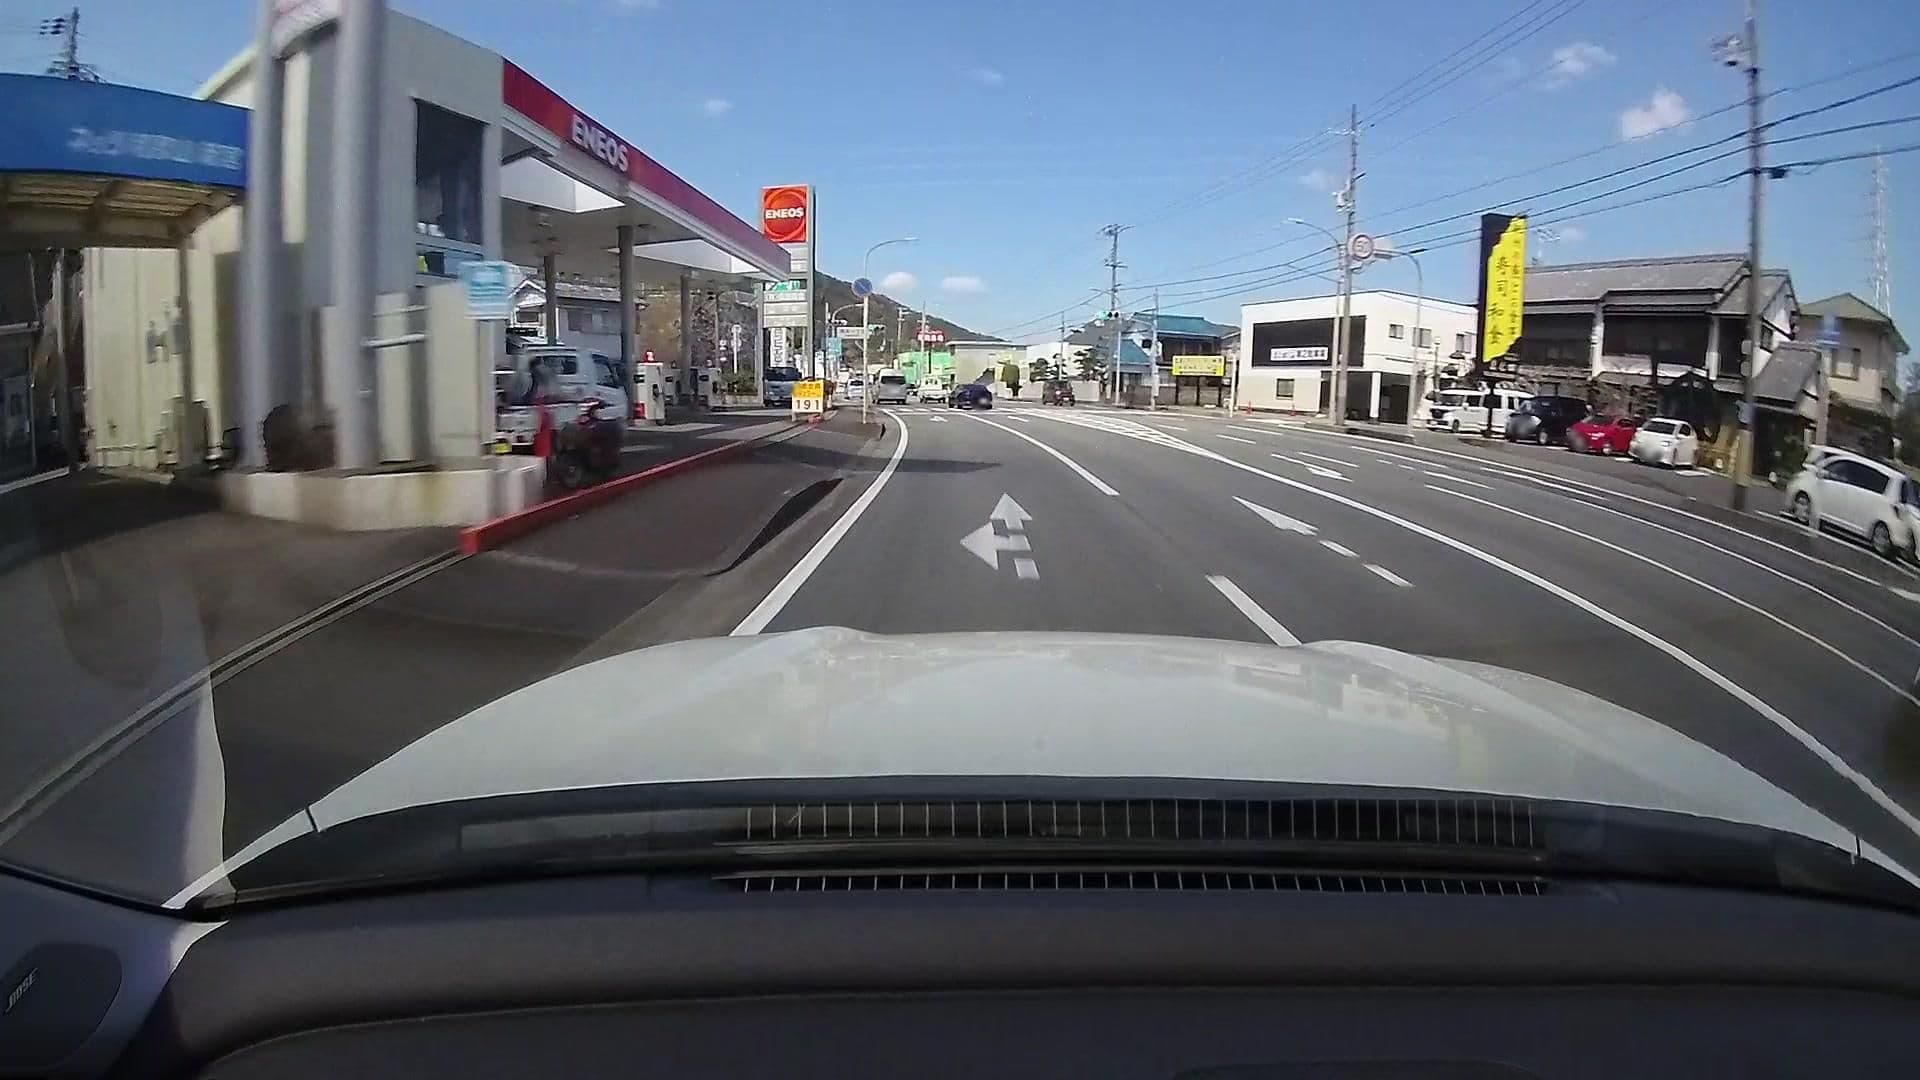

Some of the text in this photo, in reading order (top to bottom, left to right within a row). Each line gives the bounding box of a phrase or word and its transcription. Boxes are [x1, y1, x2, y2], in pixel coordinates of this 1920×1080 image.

[572, 114, 629, 172] ENEOS
[765, 207, 804, 219] ENEOS
[796, 400, 820, 410] 191
